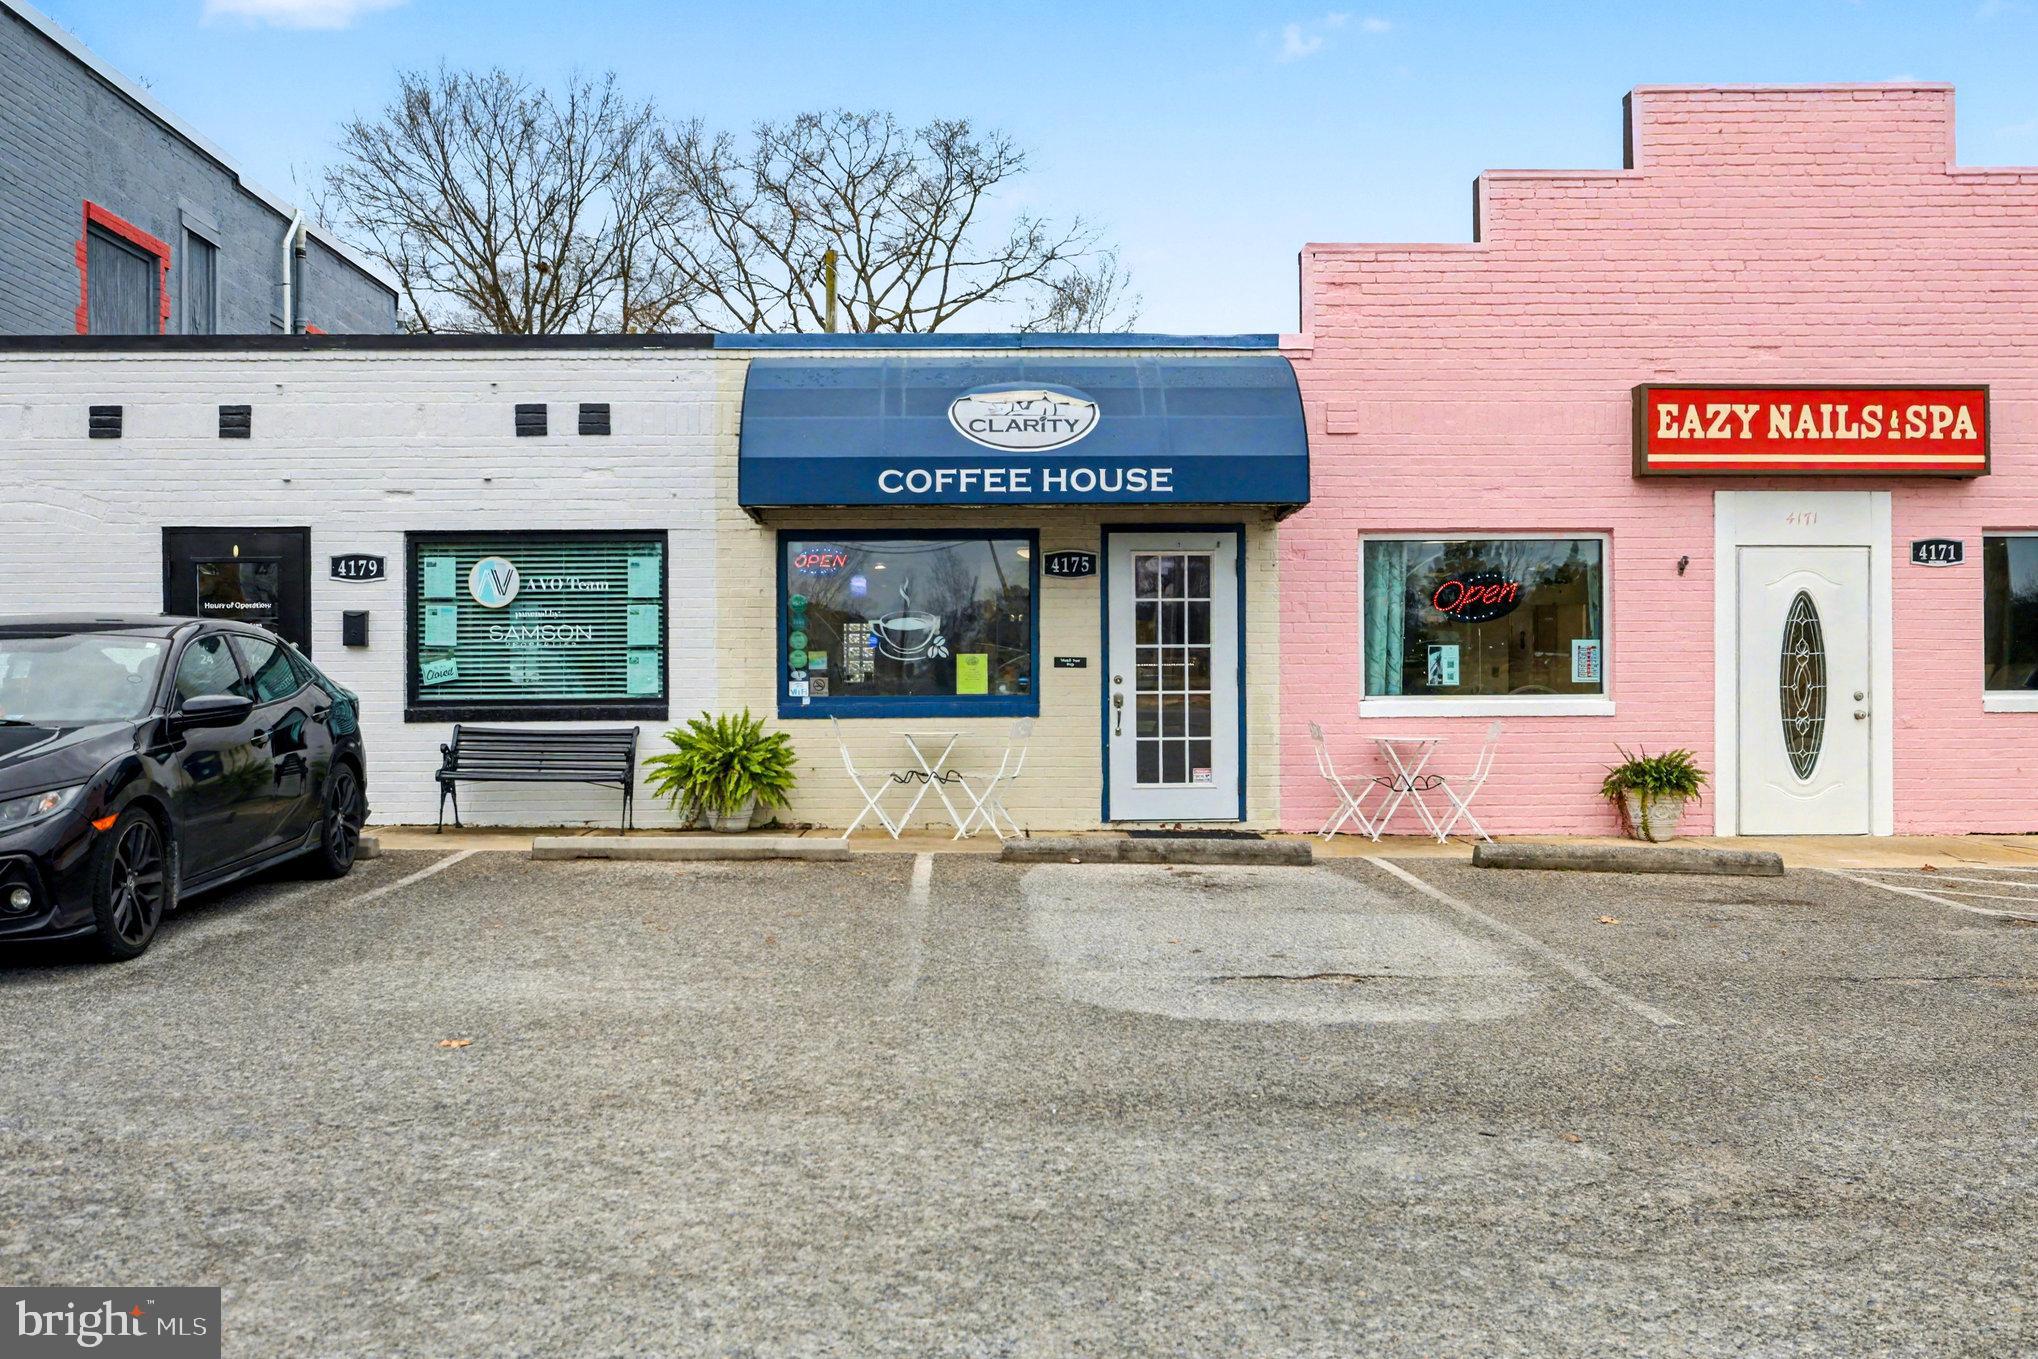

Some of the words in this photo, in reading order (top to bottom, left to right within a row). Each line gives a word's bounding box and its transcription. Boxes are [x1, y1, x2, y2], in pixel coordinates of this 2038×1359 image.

[969, 416, 1080, 433] CLARITY
[1656, 404, 1760, 439] EAZY
[1767, 404, 1883, 439] NAILS
[1905, 405, 1977, 440] SPA
[878, 468, 1032, 494] COFFEE
[1042, 468, 1173, 492] HOUSE
[1785, 511, 1818, 526] 4171
[1918, 544, 1956, 560] 4171
[337, 559, 378, 576] 4179
[794, 554, 848, 568] OPEN
[1050, 556, 1090, 573] 4175
[566, 578, 609, 591] Team
[1433, 580, 1520, 615] Open
[489, 625, 592, 641] SAMSON
